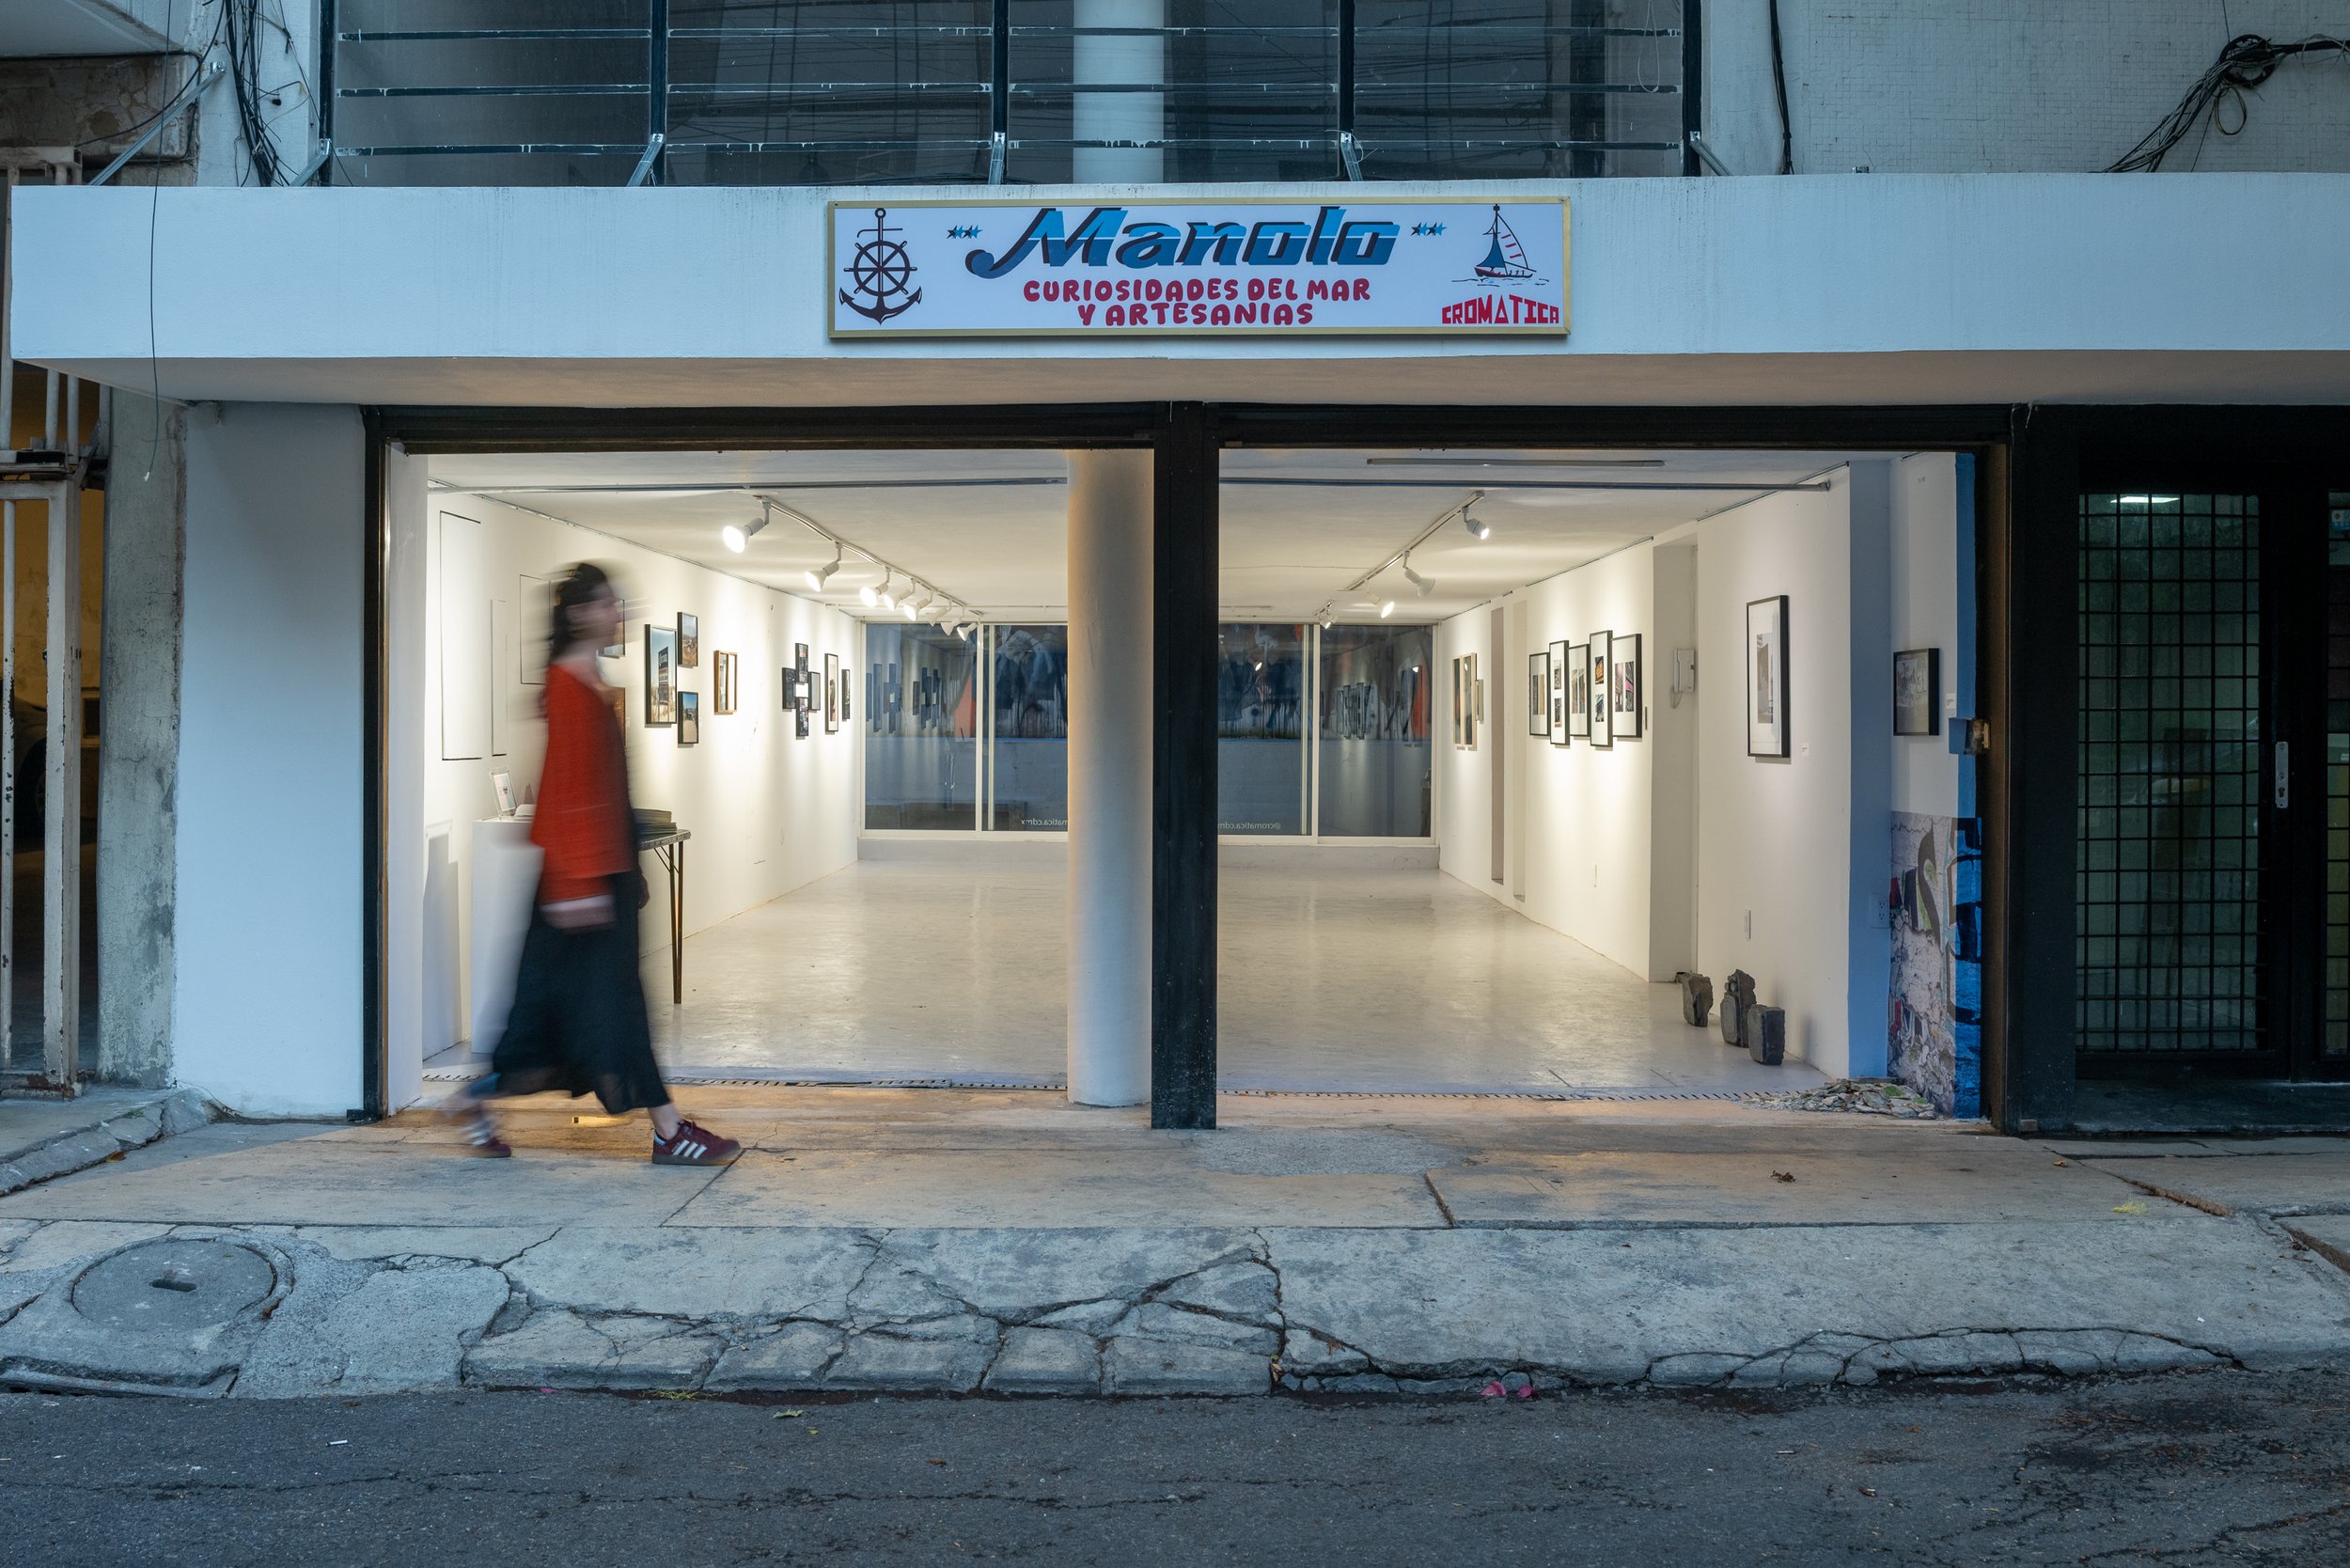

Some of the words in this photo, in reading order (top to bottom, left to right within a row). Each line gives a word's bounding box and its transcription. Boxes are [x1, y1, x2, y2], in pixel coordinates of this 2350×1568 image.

[965, 206, 1401, 279] Manolo
[1024, 278, 1239, 302] CURIOSIDADES
[1247, 278, 1298, 301] DEL
[1307, 278, 1371, 301] MAR
[1078, 304, 1096, 326] Y
[1105, 302, 1313, 326] ARTESANIAS
[1442, 294, 1559, 324] CROMATICA
